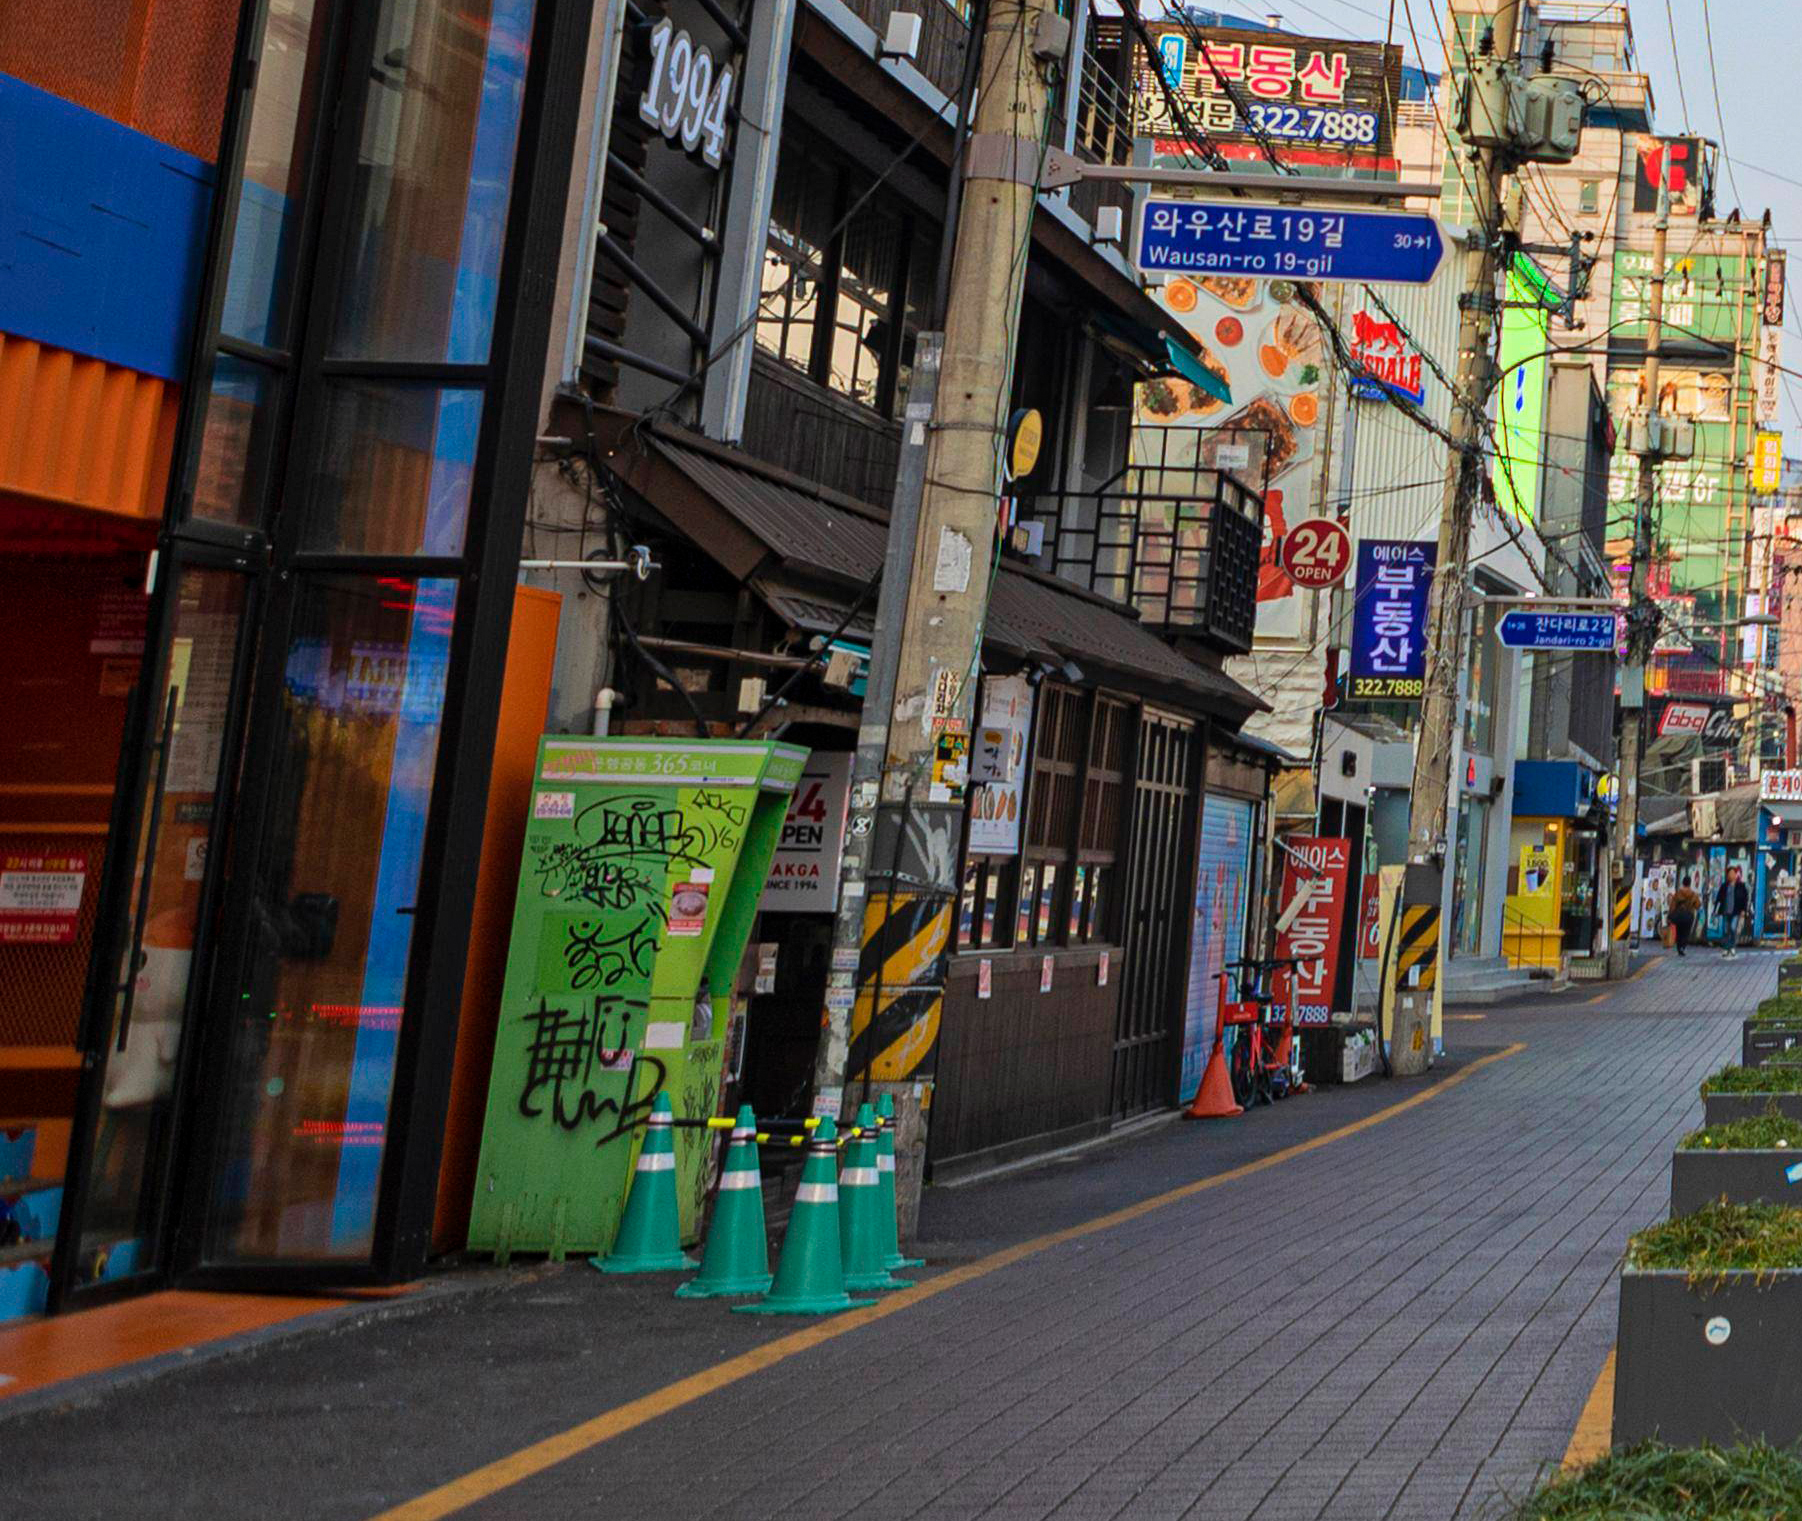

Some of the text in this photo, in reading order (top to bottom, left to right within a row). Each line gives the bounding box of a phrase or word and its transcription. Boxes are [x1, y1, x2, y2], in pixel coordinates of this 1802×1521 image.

[1196, 41, 1350, 104] 부동산
[640, 23, 735, 164] 1994
[1249, 104, 1377, 143] 322.7888
[1150, 208, 1345, 249] 와우산로19길
[1149, 245, 1333, 277] Wausan-ro 19-gil
[1291, 530, 1341, 567] 24
[1373, 543, 1425, 563] 에이스
[1295, 567, 1331, 581] OPEN
[1369, 564, 1414, 672] 부동산
[1536, 617, 1613, 634] 잔다리로2길
[1534, 634, 1613, 648] Jandari-ro 2-gil
[1355, 678, 1422, 698] 322.7888
[1282, 877, 1335, 995] 부동산
